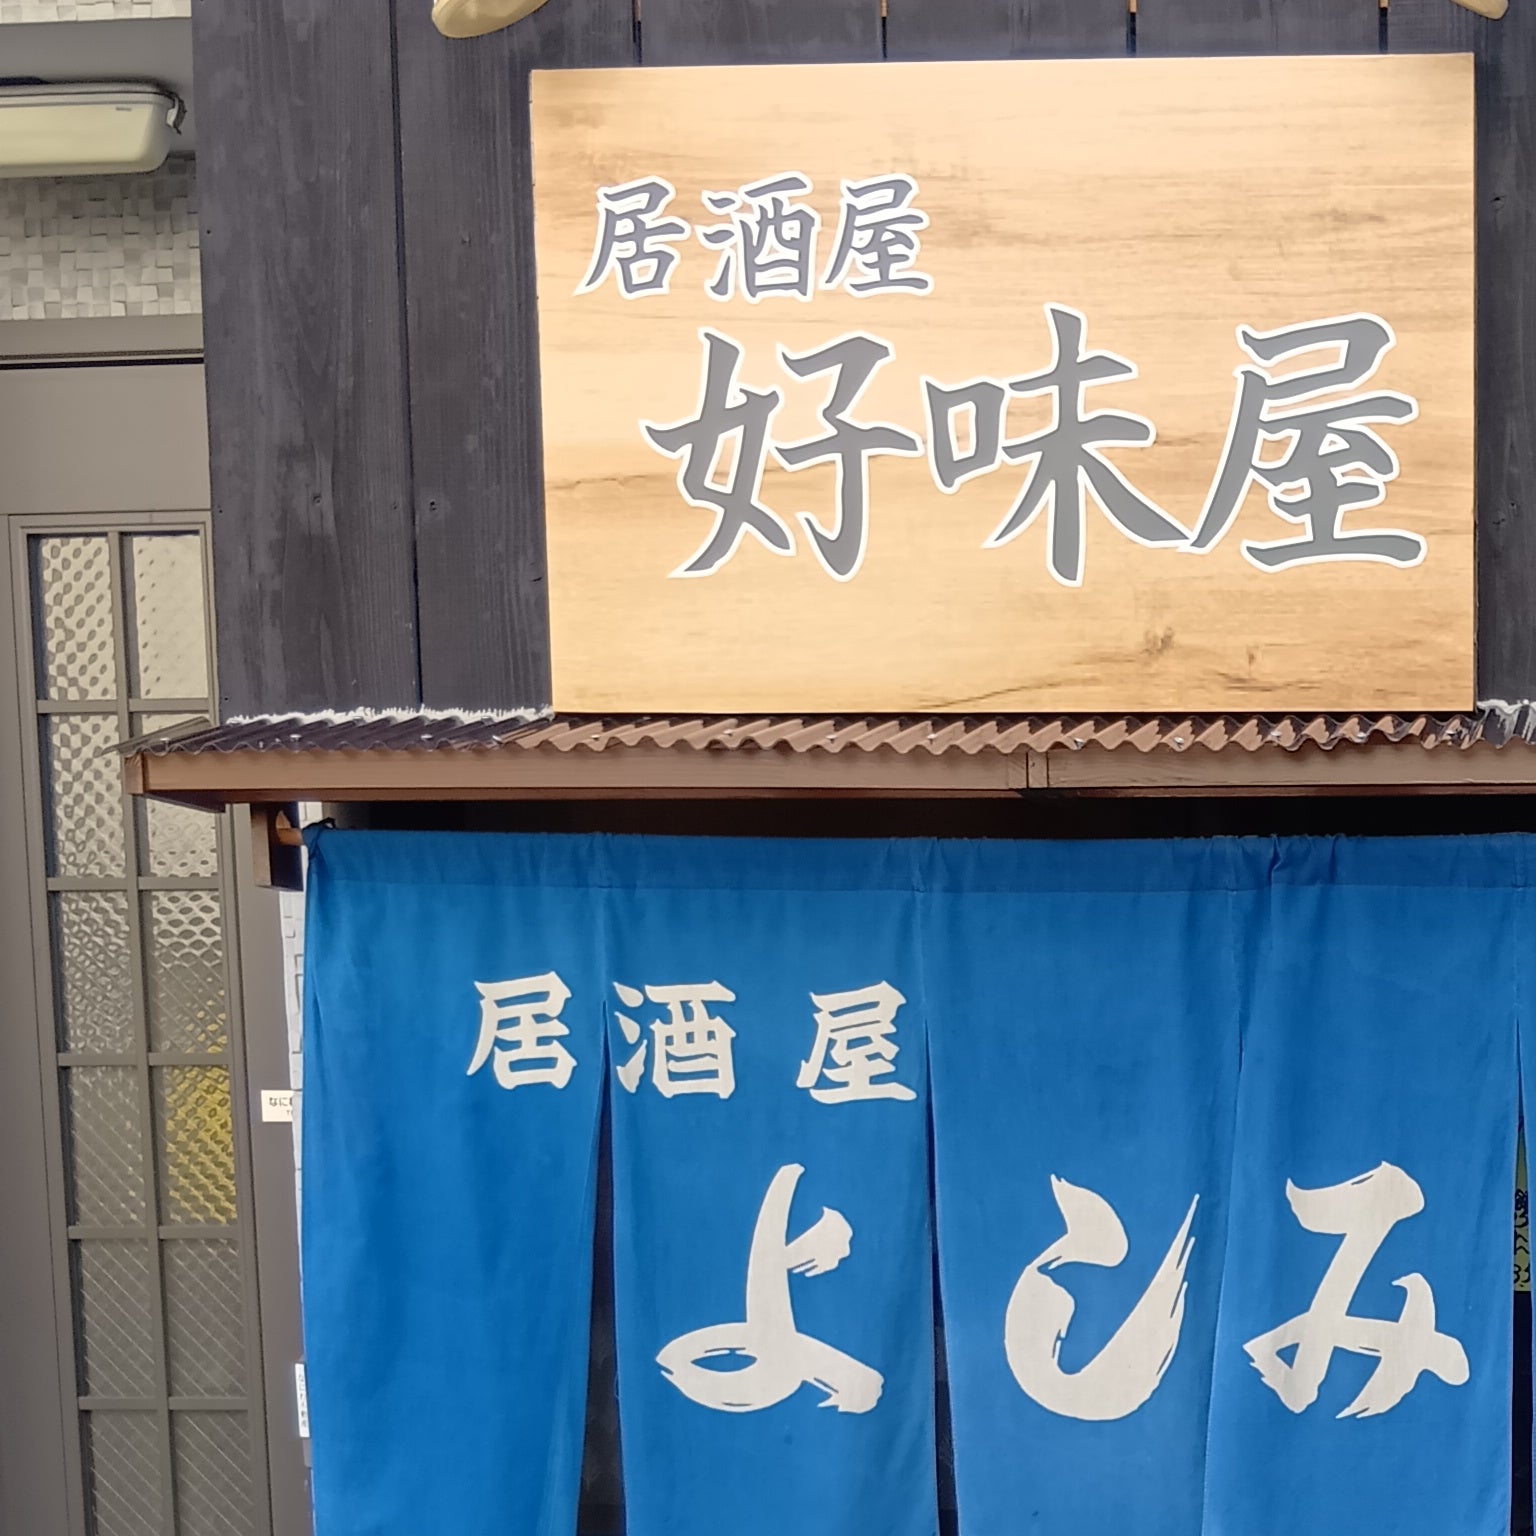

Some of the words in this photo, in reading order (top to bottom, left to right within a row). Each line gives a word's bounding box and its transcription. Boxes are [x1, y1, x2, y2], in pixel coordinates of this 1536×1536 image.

[576, 172, 933, 302] 居酒屋
[639, 302, 1429, 586] 好味屋
[466, 970, 918, 1104] 居酒屋
